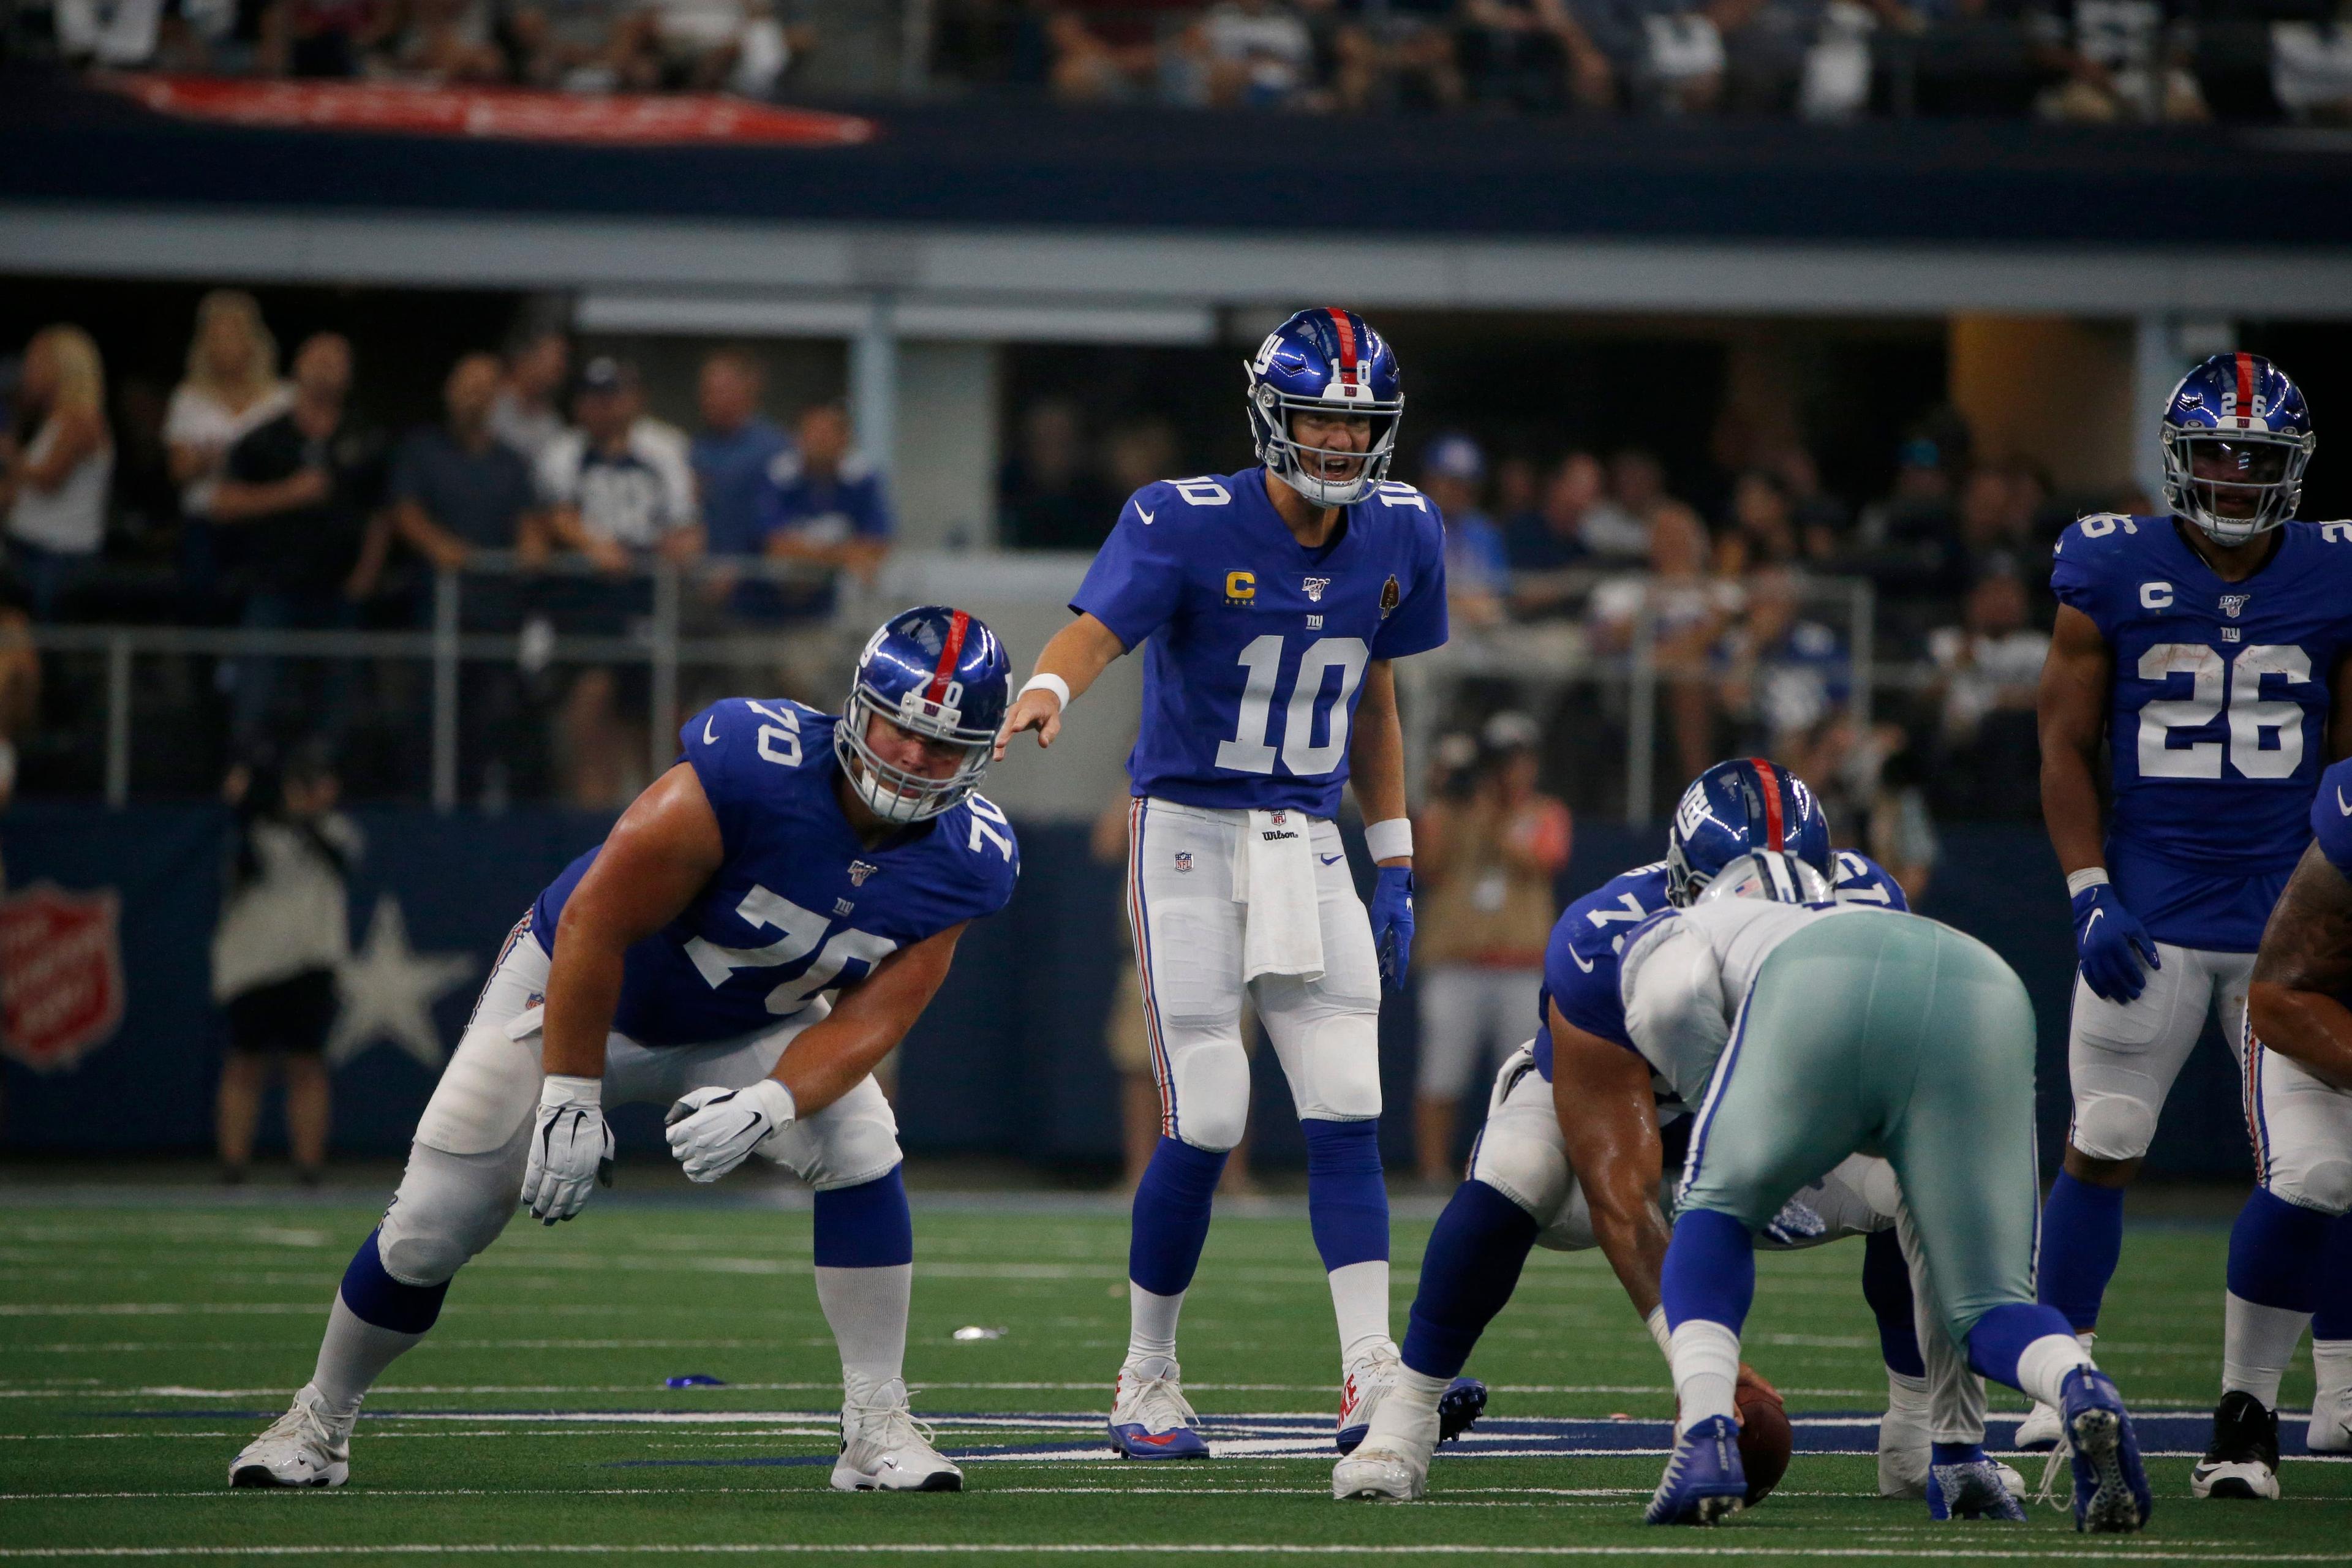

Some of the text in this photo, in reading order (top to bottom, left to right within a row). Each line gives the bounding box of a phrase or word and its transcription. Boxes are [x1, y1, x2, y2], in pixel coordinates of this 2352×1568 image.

[1226, 571, 1255, 598] C
[2140, 582, 2173, 609] C
[1215, 635, 1370, 776] 10
[2138, 643, 2312, 778] 26
[745, 701, 803, 767] 70
[964, 787, 1012, 863] 70
[1262, 830, 1295, 841] Wilson
[1273, 815, 1286, 824] NFL
[1177, 860, 1191, 870] NFL
[683, 884, 898, 1015] 70
